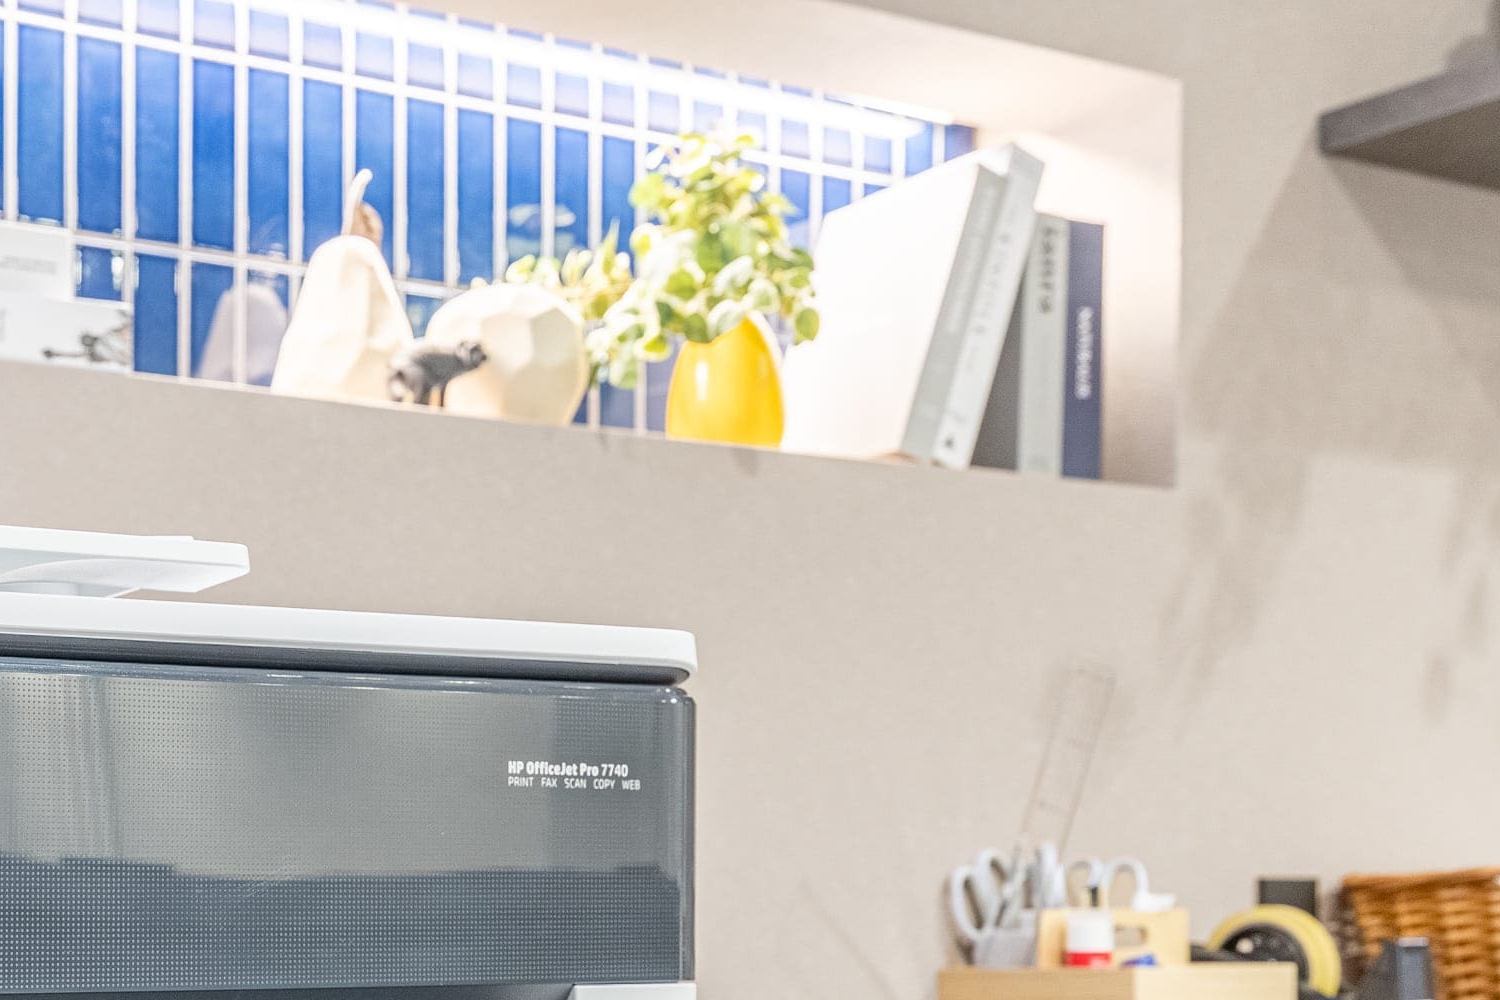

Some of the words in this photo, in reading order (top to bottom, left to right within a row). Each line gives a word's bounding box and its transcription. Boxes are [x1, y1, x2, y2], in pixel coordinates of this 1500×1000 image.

[508, 761, 524, 774] HP
[526, 761, 578, 777] OfficeJet
[579, 763, 600, 777] Pro
[601, 763, 629, 777] 7740
[508, 776, 534, 787] PRINT
[541, 777, 557, 788] FAX
[564, 777, 587, 789] SCAN
[593, 778, 616, 790] COPY
[621, 779, 641, 790] WEB
